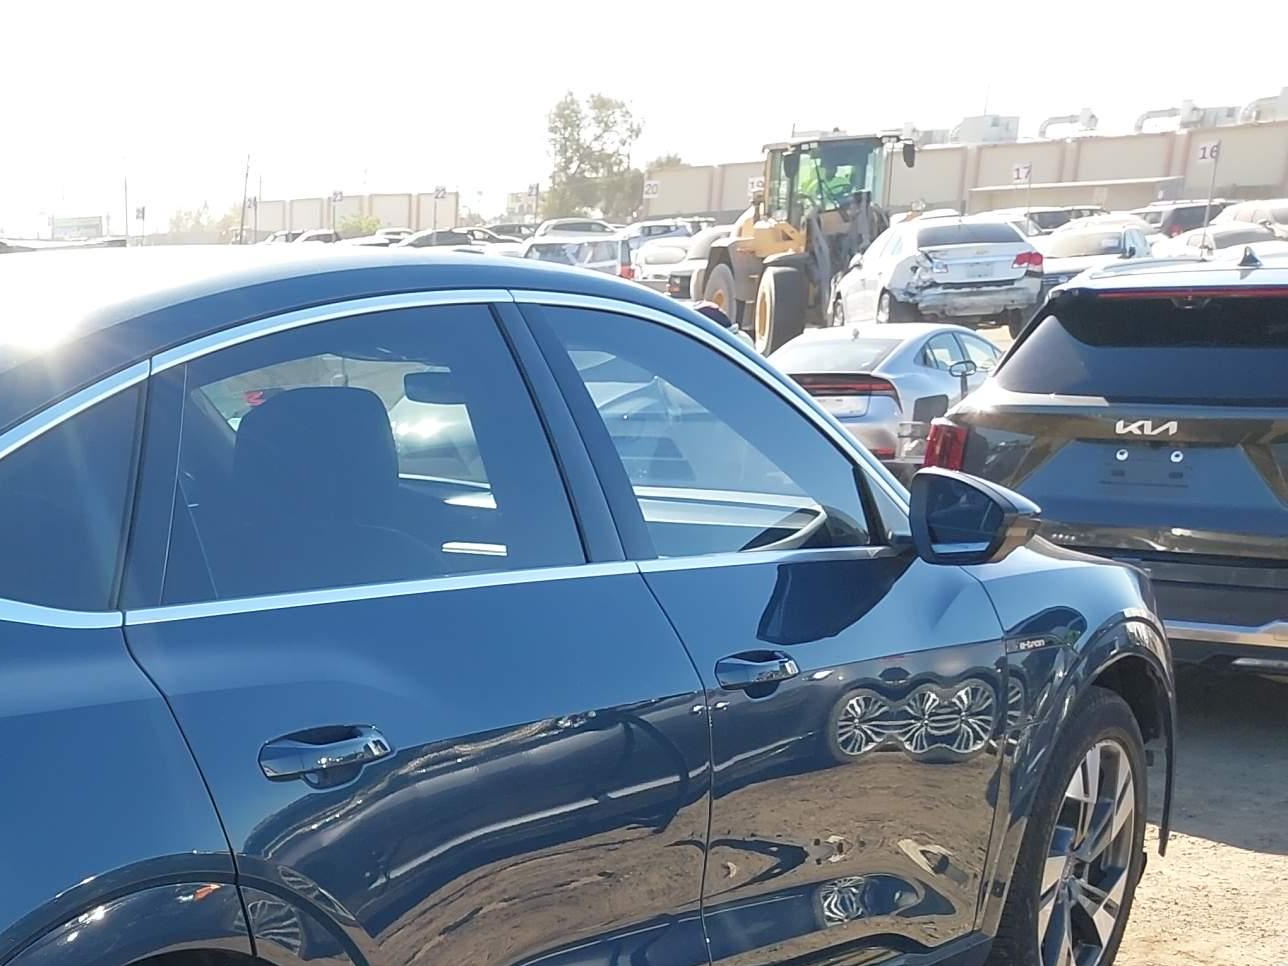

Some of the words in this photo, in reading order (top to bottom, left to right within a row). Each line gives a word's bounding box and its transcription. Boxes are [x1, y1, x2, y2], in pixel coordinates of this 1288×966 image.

[1199, 145, 1220, 160] 16
[1014, 165, 1032, 180] 17
[1115, 420, 1178, 436] KIA
[1019, 639, 1045, 650] e-tron
